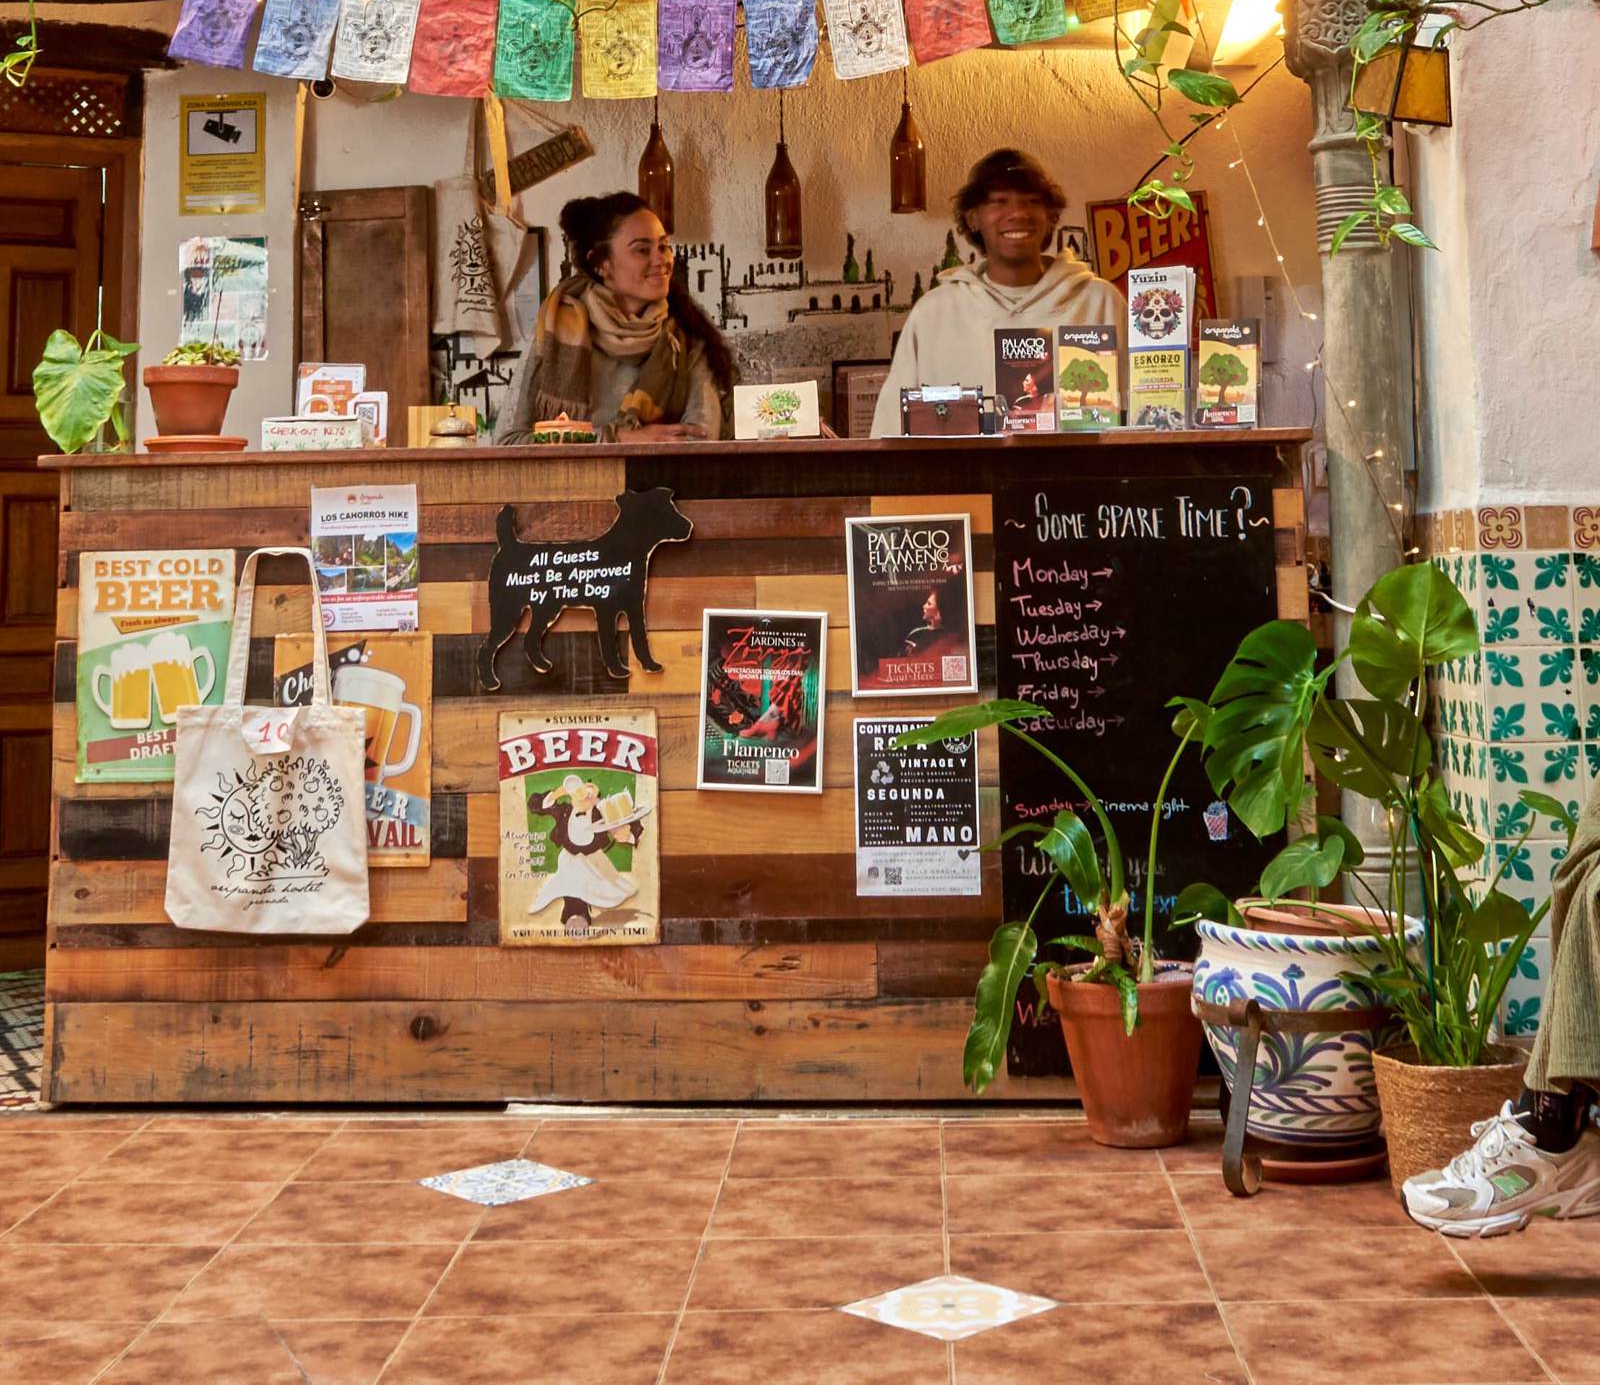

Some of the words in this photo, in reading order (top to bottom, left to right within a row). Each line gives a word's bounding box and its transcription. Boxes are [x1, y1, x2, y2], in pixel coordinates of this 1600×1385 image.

[1094, 200, 1200, 282] BEER!
[1130, 271, 1167, 284] Yuzin
[1002, 338, 1046, 349] PALACIO
[1133, 354, 1181, 366] ESKORZO
[340, 511, 386, 520] CAHORROS
[388, 511, 409, 519] HIKE
[1098, 504, 1166, 540] SPARE
[94, 559, 151, 578] BEST
[158, 558, 224, 576] COLD
[530, 552, 547, 566] All
[552, 550, 599, 564] Guests
[506, 572, 540, 586] Must
[546, 569, 562, 583] Be
[569, 562, 631, 583] Approved
[1011, 557, 1088, 590] Monday
[94, 578, 224, 613] BEER
[530, 588, 547, 604] by
[553, 586, 578, 599] The
[585, 584, 610, 598] Dog
[1010, 595, 1082, 620] Tuesday
[750, 636, 797, 647] JARDINES
[1016, 624, 1111, 646] Wednesday
[886, 663, 935, 674] TICKETS
[1012, 650, 1098, 681] Thursday
[1017, 684, 1079, 709] Friday
[552, 715, 604, 724] SUMMER
[1017, 711, 1106, 736] Saturday
[136, 729, 169, 744] BEST
[500, 729, 647, 774] BEER
[722, 739, 799, 759] Flamenco
[727, 759, 760, 768] TICKETS
[900, 758, 954, 768] VINTAGE
[960, 758, 967, 767] Y
[867, 788, 945, 800] SEGUNDA
[1014, 797, 1073, 818] Sunday
[905, 826, 974, 843] MANO
[513, 929, 532, 937] YOU
[539, 929, 560, 937] ARE
[563, 928, 597, 937] RIGHT
[623, 927, 649, 936] TIME
